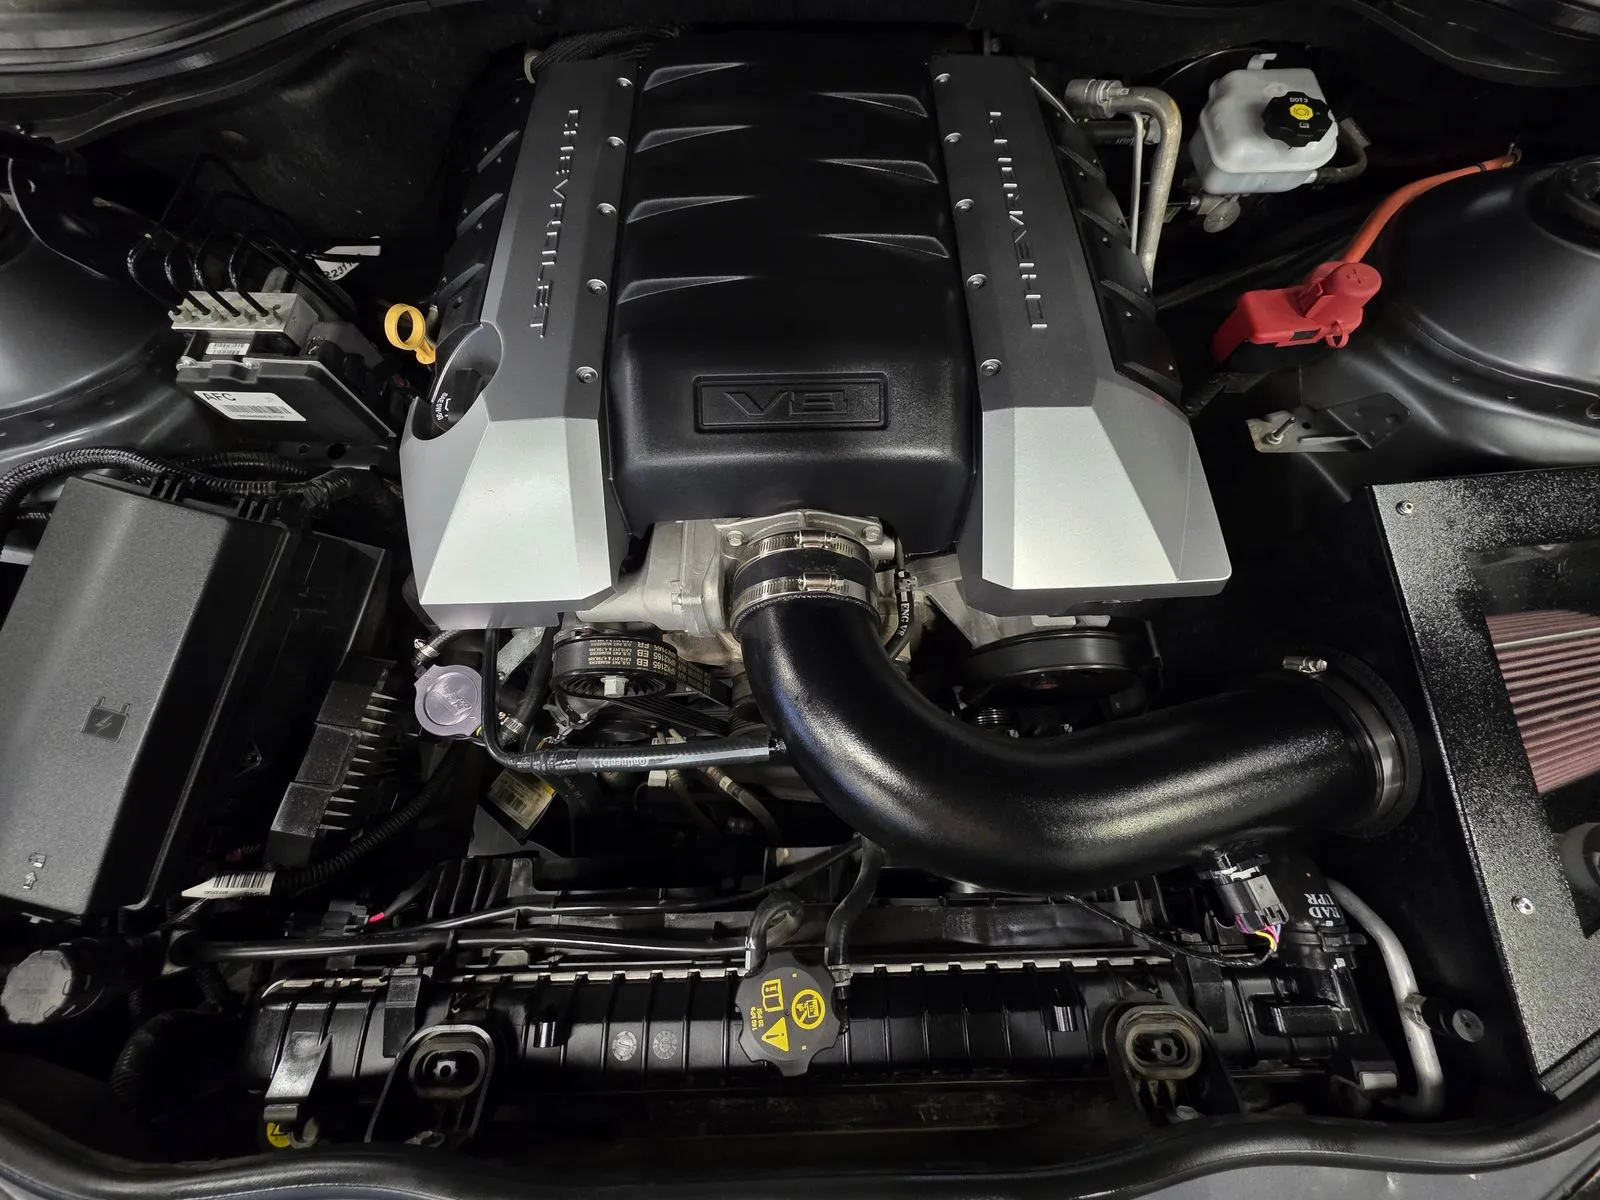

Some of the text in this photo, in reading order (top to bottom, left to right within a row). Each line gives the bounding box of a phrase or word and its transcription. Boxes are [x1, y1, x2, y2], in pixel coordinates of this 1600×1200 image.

[529, 108, 580, 339] CHEVROLET
[988, 110, 1048, 328] CHEVROLET
[721, 390, 847, 416] V8
[900, 602, 910, 623] ENG
[637, 649, 649, 658] EB
[636, 658, 648, 667] EB
[599, 757, 649, 768] Continental
[1304, 893, 1335, 905] UPR
[1308, 906, 1341, 919] RAD
